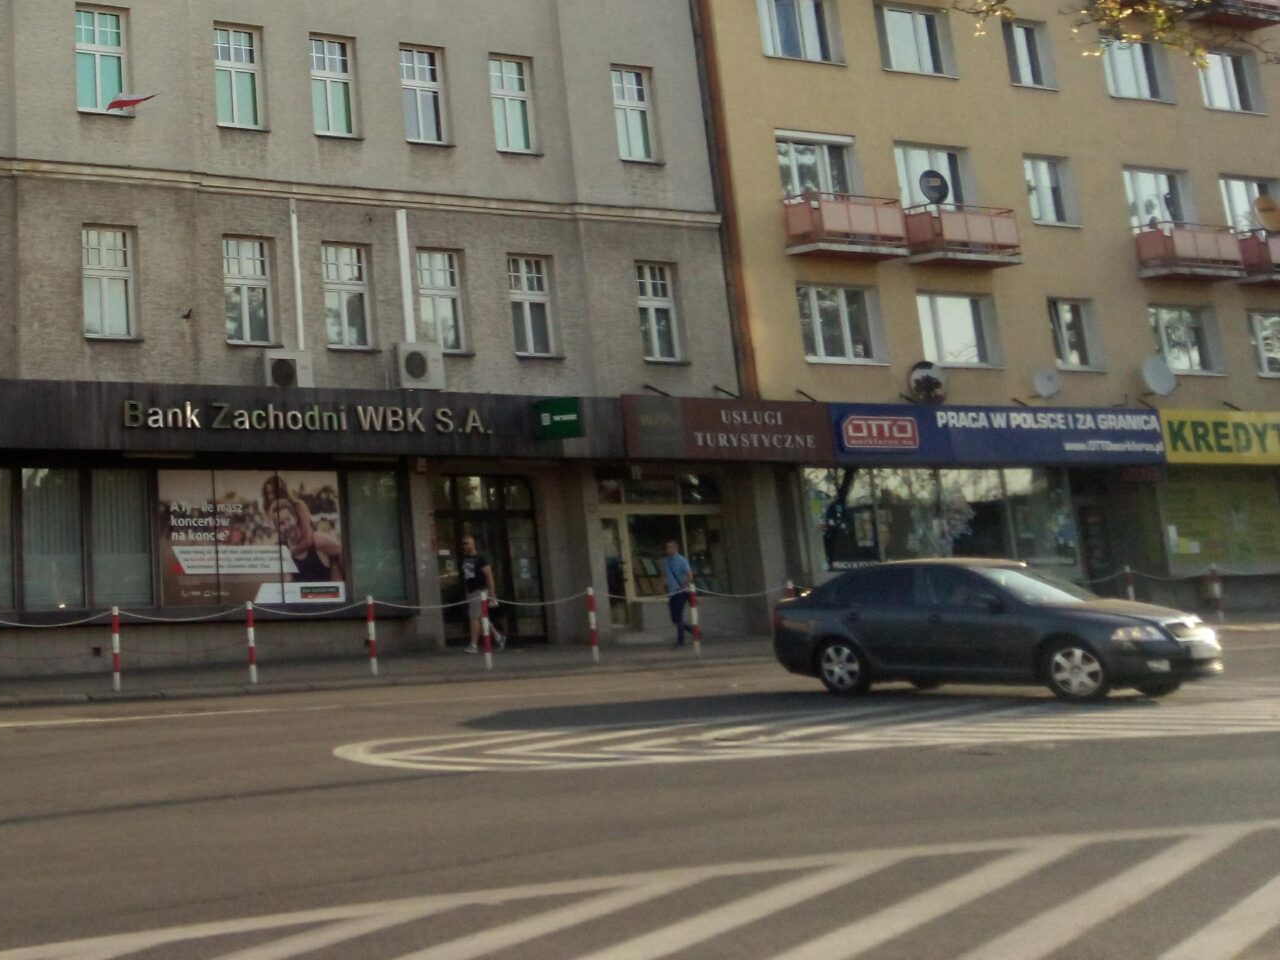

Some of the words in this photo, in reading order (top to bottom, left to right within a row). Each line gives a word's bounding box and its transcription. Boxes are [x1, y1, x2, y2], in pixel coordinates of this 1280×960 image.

[123, 401, 201, 429] Bank
[211, 402, 348, 431] Zachodni
[356, 405, 426, 433] WBK
[435, 408, 494, 435] S.A.
[936, 411, 989, 429] PRACA
[990, 412, 1007, 429] W
[1010, 413, 1066, 429] POLSCE
[1076, 414, 1096, 430] ZA
[847, 419, 913, 438] OTTO
[694, 432, 816, 449] TURYSTYCZNE
[171, 532, 185, 541] na
